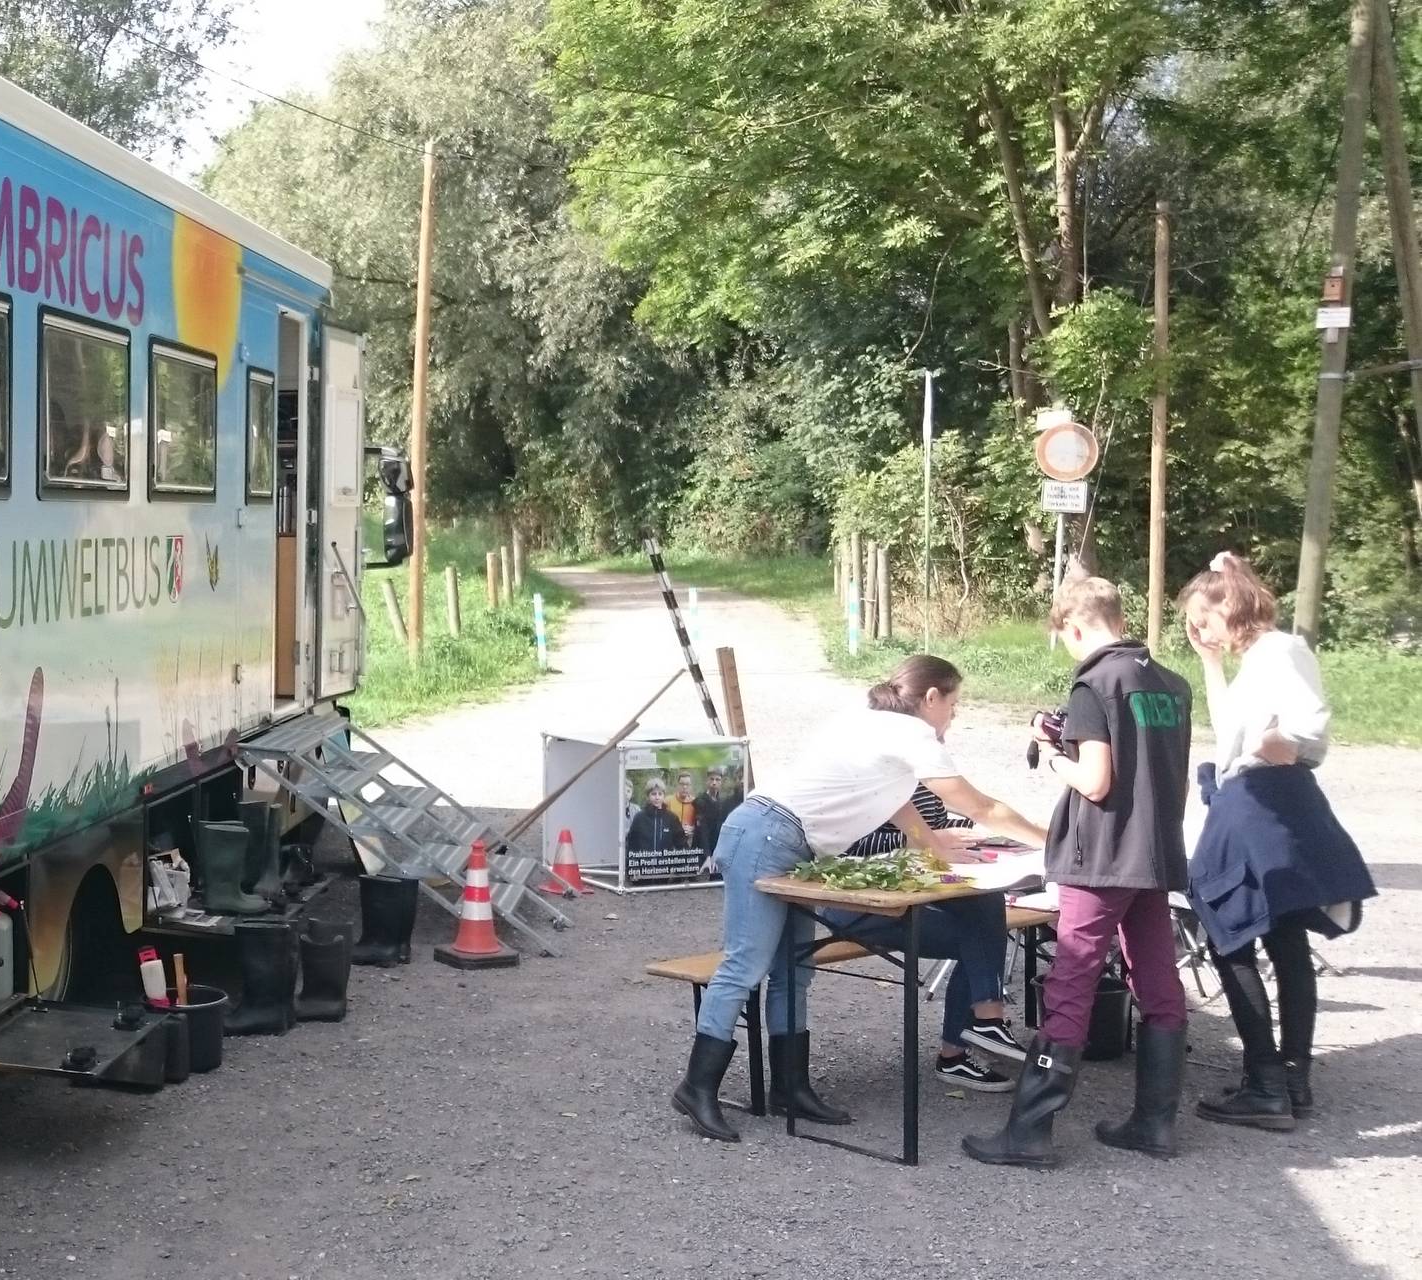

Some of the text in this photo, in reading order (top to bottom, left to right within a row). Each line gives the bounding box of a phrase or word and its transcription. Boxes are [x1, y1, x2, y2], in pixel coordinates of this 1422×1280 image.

[628, 850, 662, 858] Praktische
[640, 859, 657, 867] Profil
[658, 857, 685, 865] erstellen
[628, 868, 640, 876] den
[641, 867, 669, 875] Horizont
